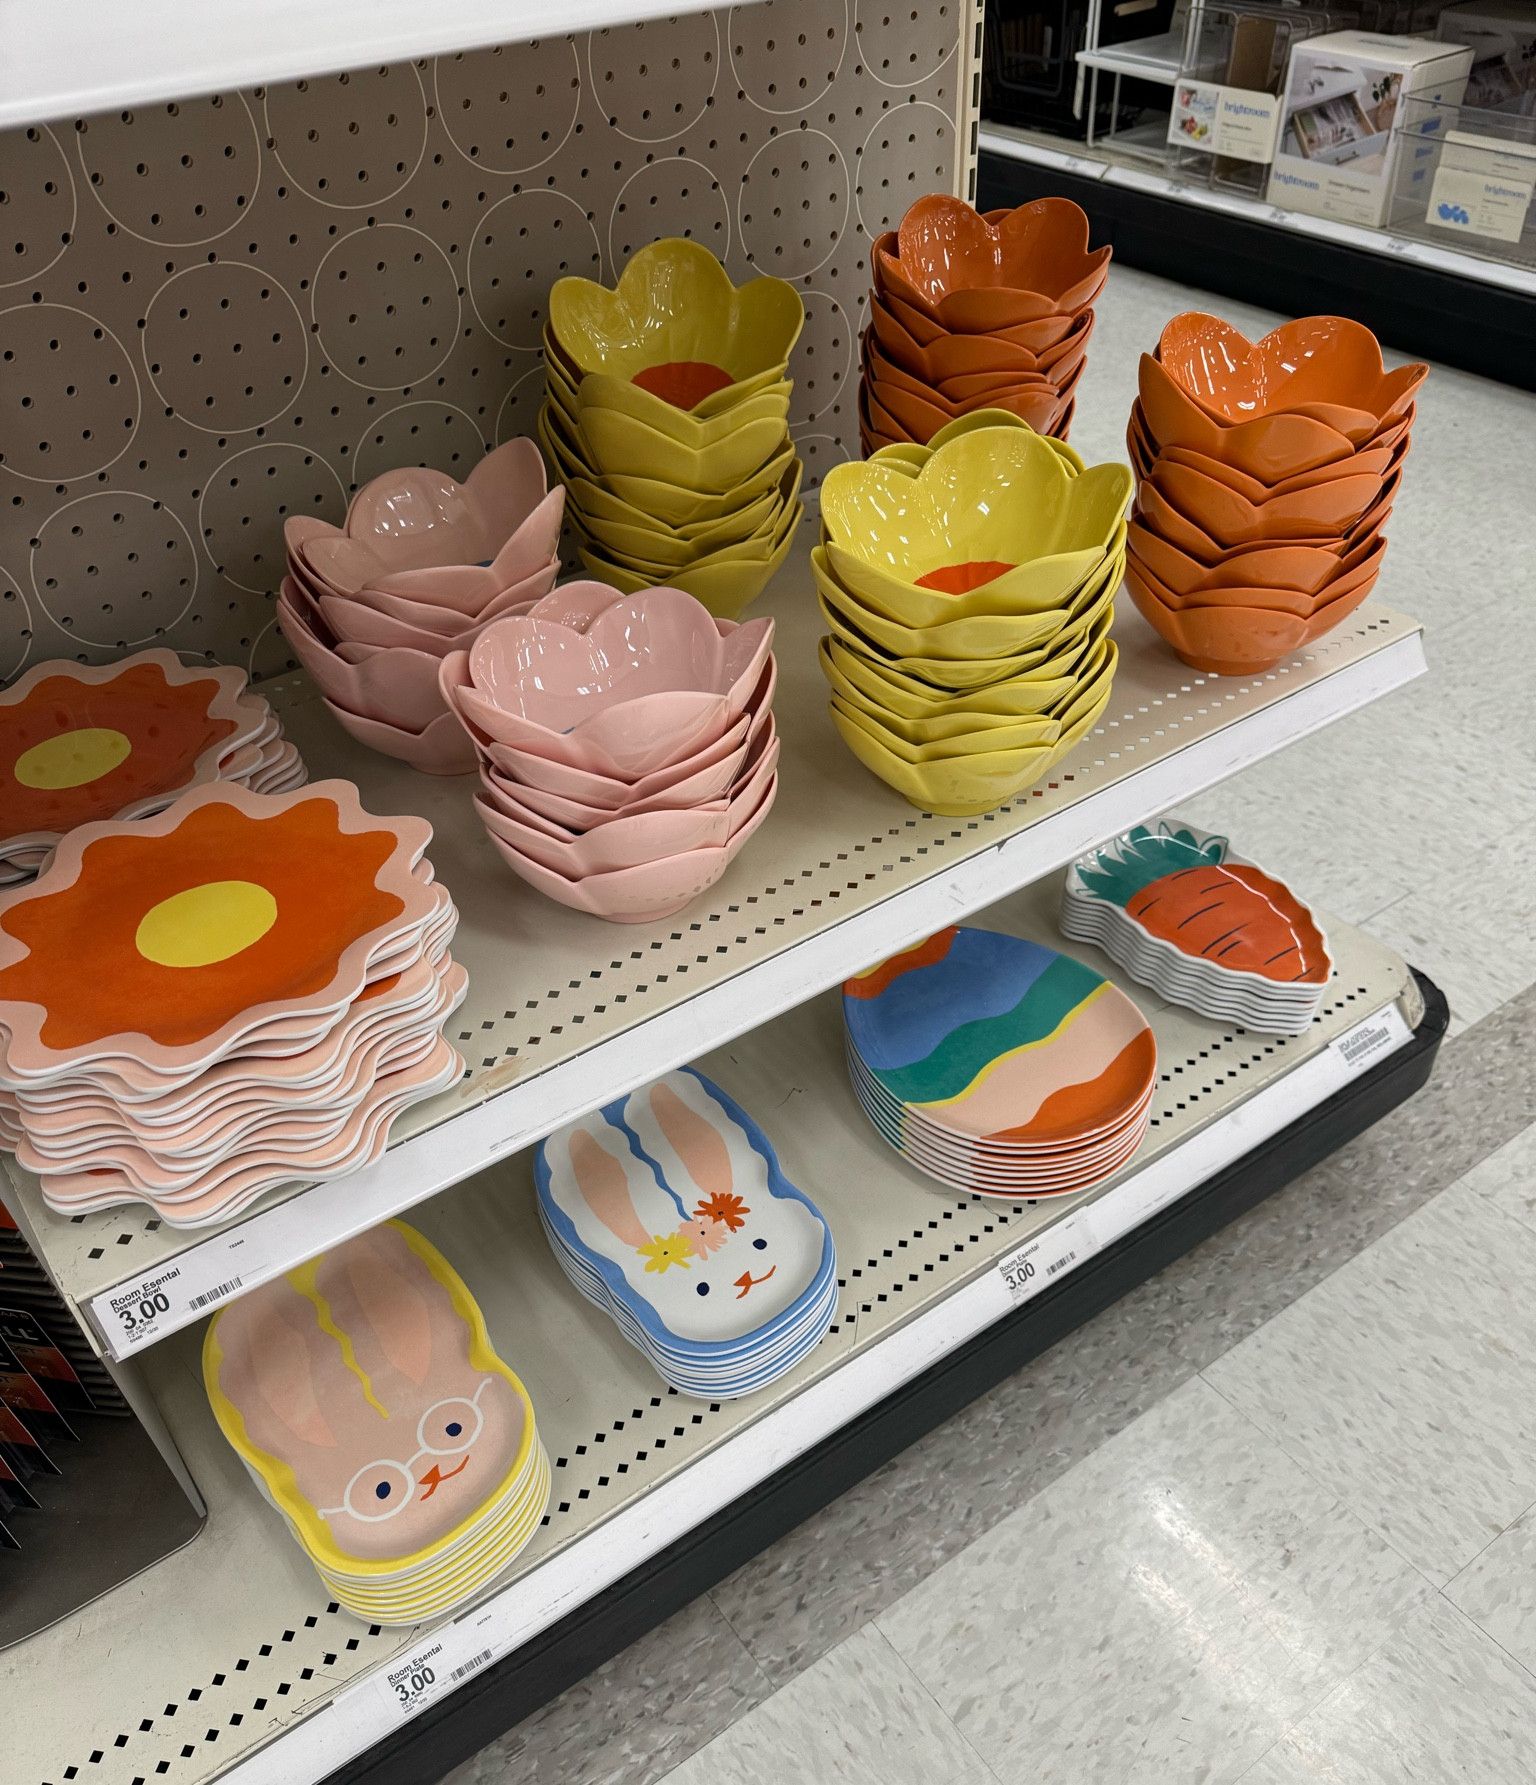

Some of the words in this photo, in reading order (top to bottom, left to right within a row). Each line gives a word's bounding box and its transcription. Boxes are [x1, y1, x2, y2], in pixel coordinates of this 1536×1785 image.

[1224, 100, 1270, 120] brightroom
[1273, 170, 1320, 192] brightroom
[1484, 183, 1528, 201] brightroom
[999, 1259, 1018, 1274] Room
[1017, 1243, 1040, 1261] Esental
[109, 1289, 141, 1309] Room
[142, 1267, 181, 1292] Esental
[1005, 1262, 1036, 1290] 3.00
[113, 1296, 143, 1314] Dessert
[142, 1286, 162, 1300] Bowl
[118, 1293, 170, 1331] 3.00
[387, 1664, 413, 1683] Room
[412, 1643, 443, 1666] Esental
[390, 1673, 410, 1688] Dinner
[409, 1663, 425, 1675] Plate
[395, 1666, 436, 1702] 3.00
